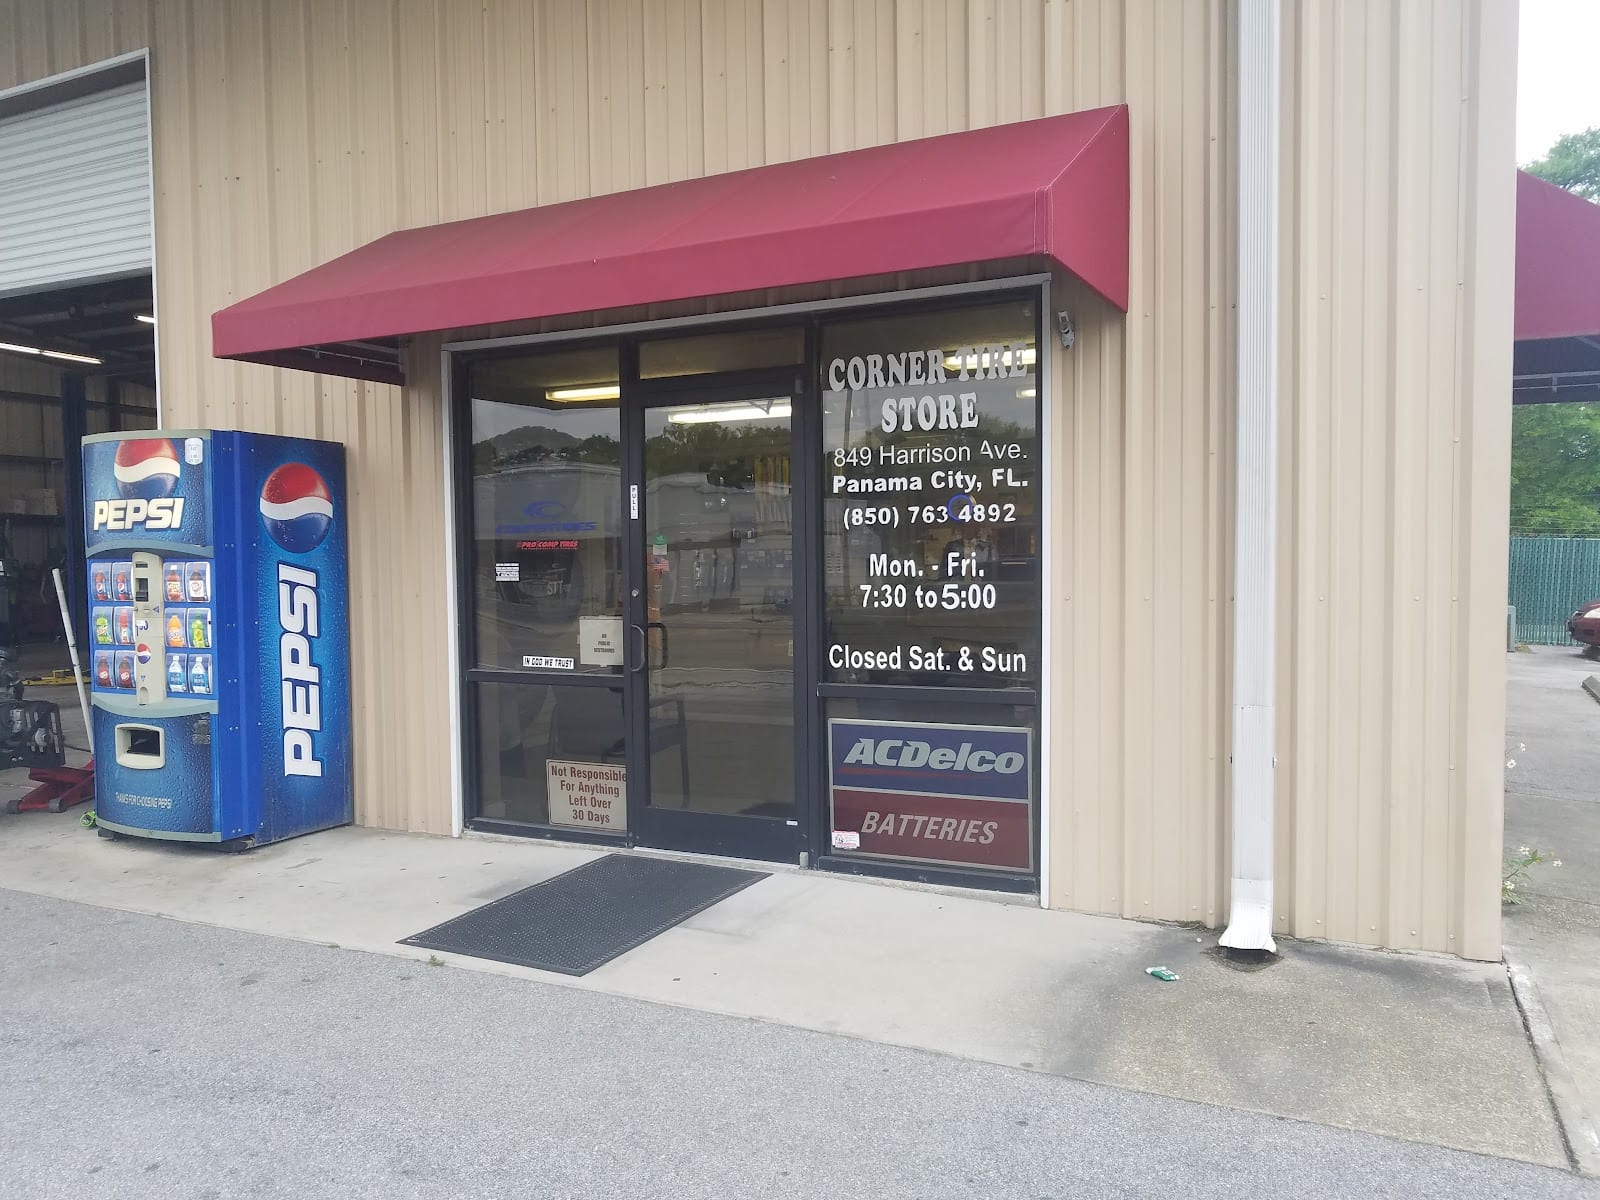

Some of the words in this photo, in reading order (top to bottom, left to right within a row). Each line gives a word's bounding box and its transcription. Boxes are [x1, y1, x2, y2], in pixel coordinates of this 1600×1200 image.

[829, 349, 947, 392] CORNER
[955, 342, 1028, 382] TIRE
[881, 392, 979, 433] STORE
[834, 447, 872, 467] 849
[880, 443, 971, 466] Harrison
[980, 440, 1028, 460] Ave.
[832, 475, 923, 494] Panama
[931, 470, 982, 493] City,
[992, 468, 1029, 487] FL.
[93, 498, 185, 531] PEPSI
[843, 507, 899, 529] (850)
[908, 506, 949, 524] 763
[958, 504, 1016, 523] 4892
[869, 553, 923, 577] Mon.
[947, 552, 985, 577] Fri.
[860, 584, 907, 608] 7:30
[915, 586, 938, 608] to
[941, 584, 996, 610] 5:00
[279, 563, 322, 776] PEPSI
[524, 657, 530, 666] IN
[532, 657, 543, 666] GOD
[544, 658, 553, 667] WE
[555, 659, 573, 668] TRUST
[829, 644, 901, 670] Closed
[909, 645, 951, 671] Sat.
[958, 646, 974, 671] &
[982, 646, 1026, 673] Sun
[843, 737, 1025, 774] ACDelco
[551, 765, 567, 777] Not
[570, 767, 628, 782] Responsible
[560, 780, 575, 792] For
[578, 781, 620, 798] Anything
[568, 794, 588, 807] Left
[590, 796, 612, 809] Over
[572, 809, 584, 821] 30
[587, 810, 610, 824] Days
[860, 811, 999, 845] BATTERIES
